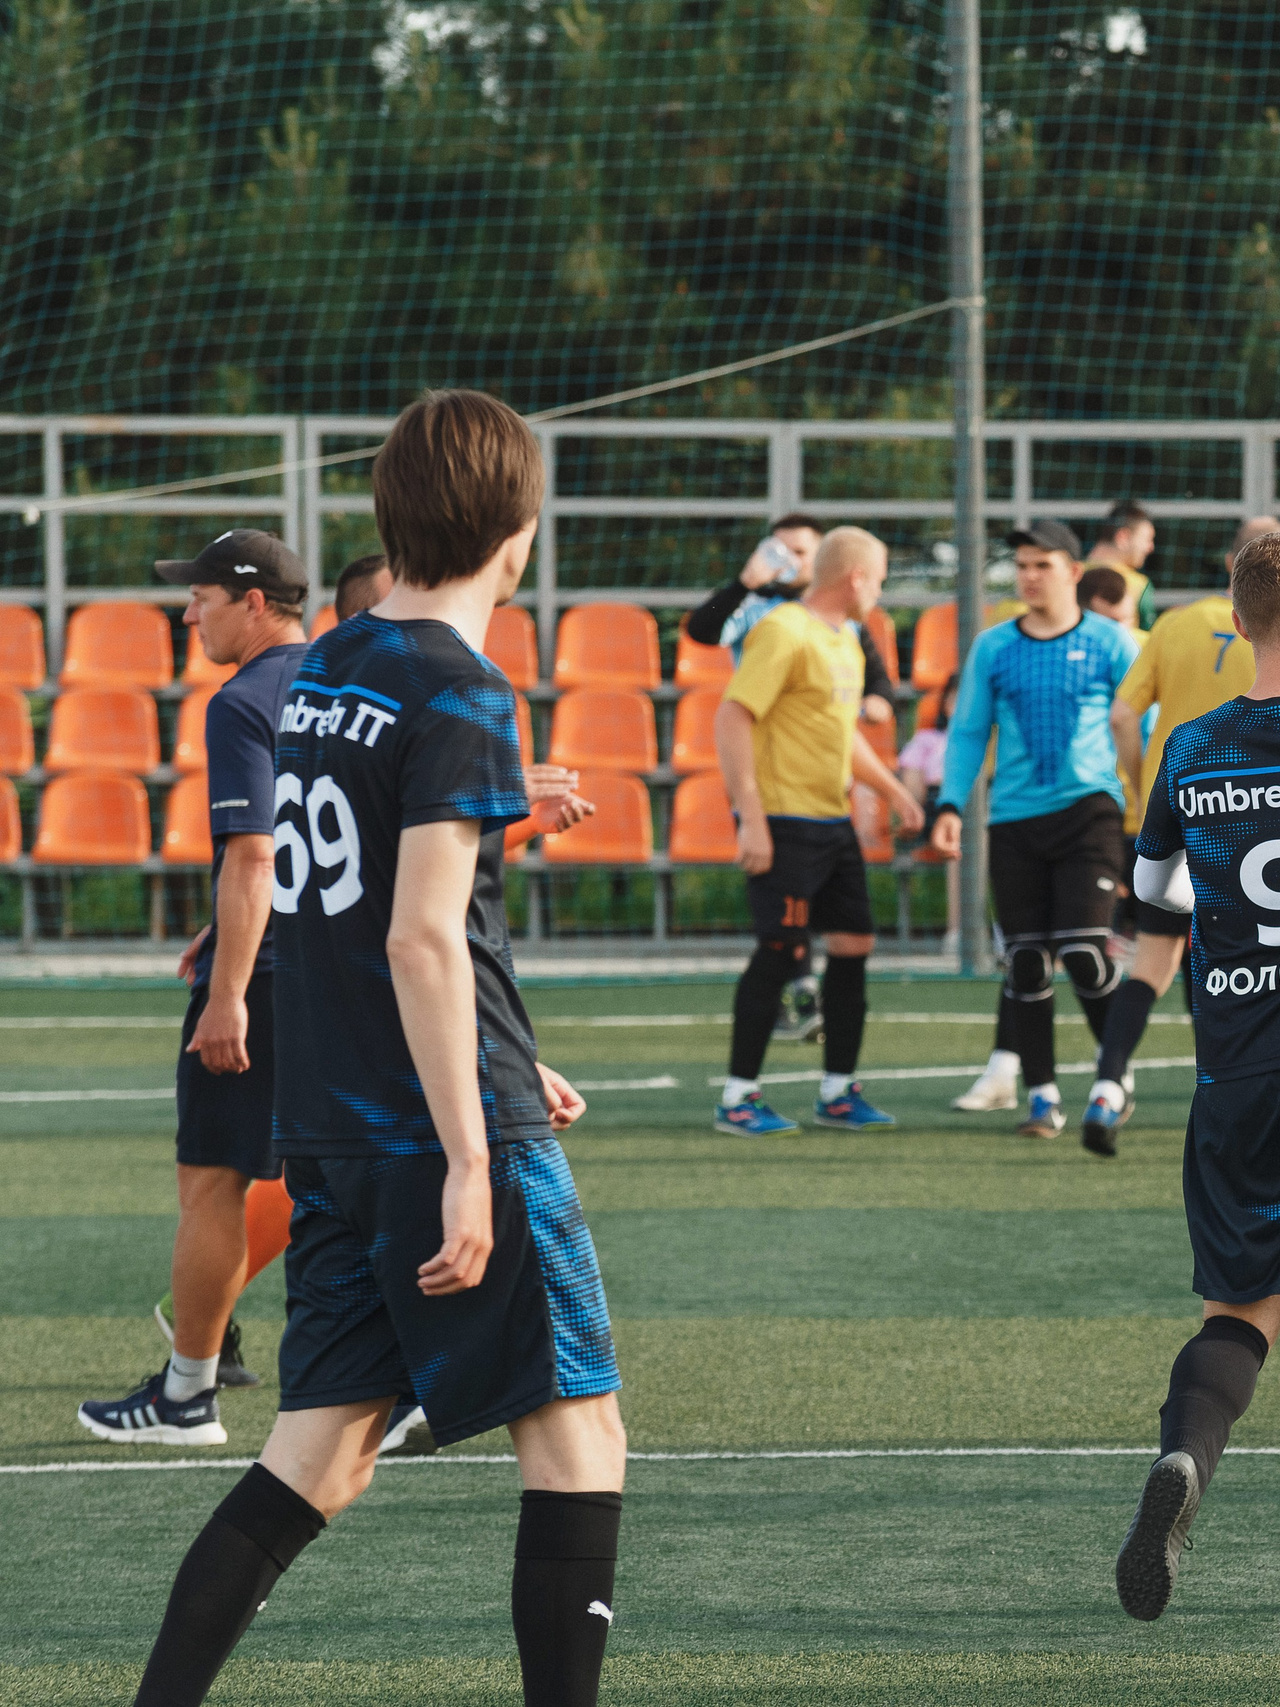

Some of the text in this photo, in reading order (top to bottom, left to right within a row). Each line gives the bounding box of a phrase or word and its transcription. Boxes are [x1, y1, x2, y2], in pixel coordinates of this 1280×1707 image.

[1212, 631, 1236, 673] 7
[343, 702, 397, 748] IT
[272, 772, 364, 917] 69
